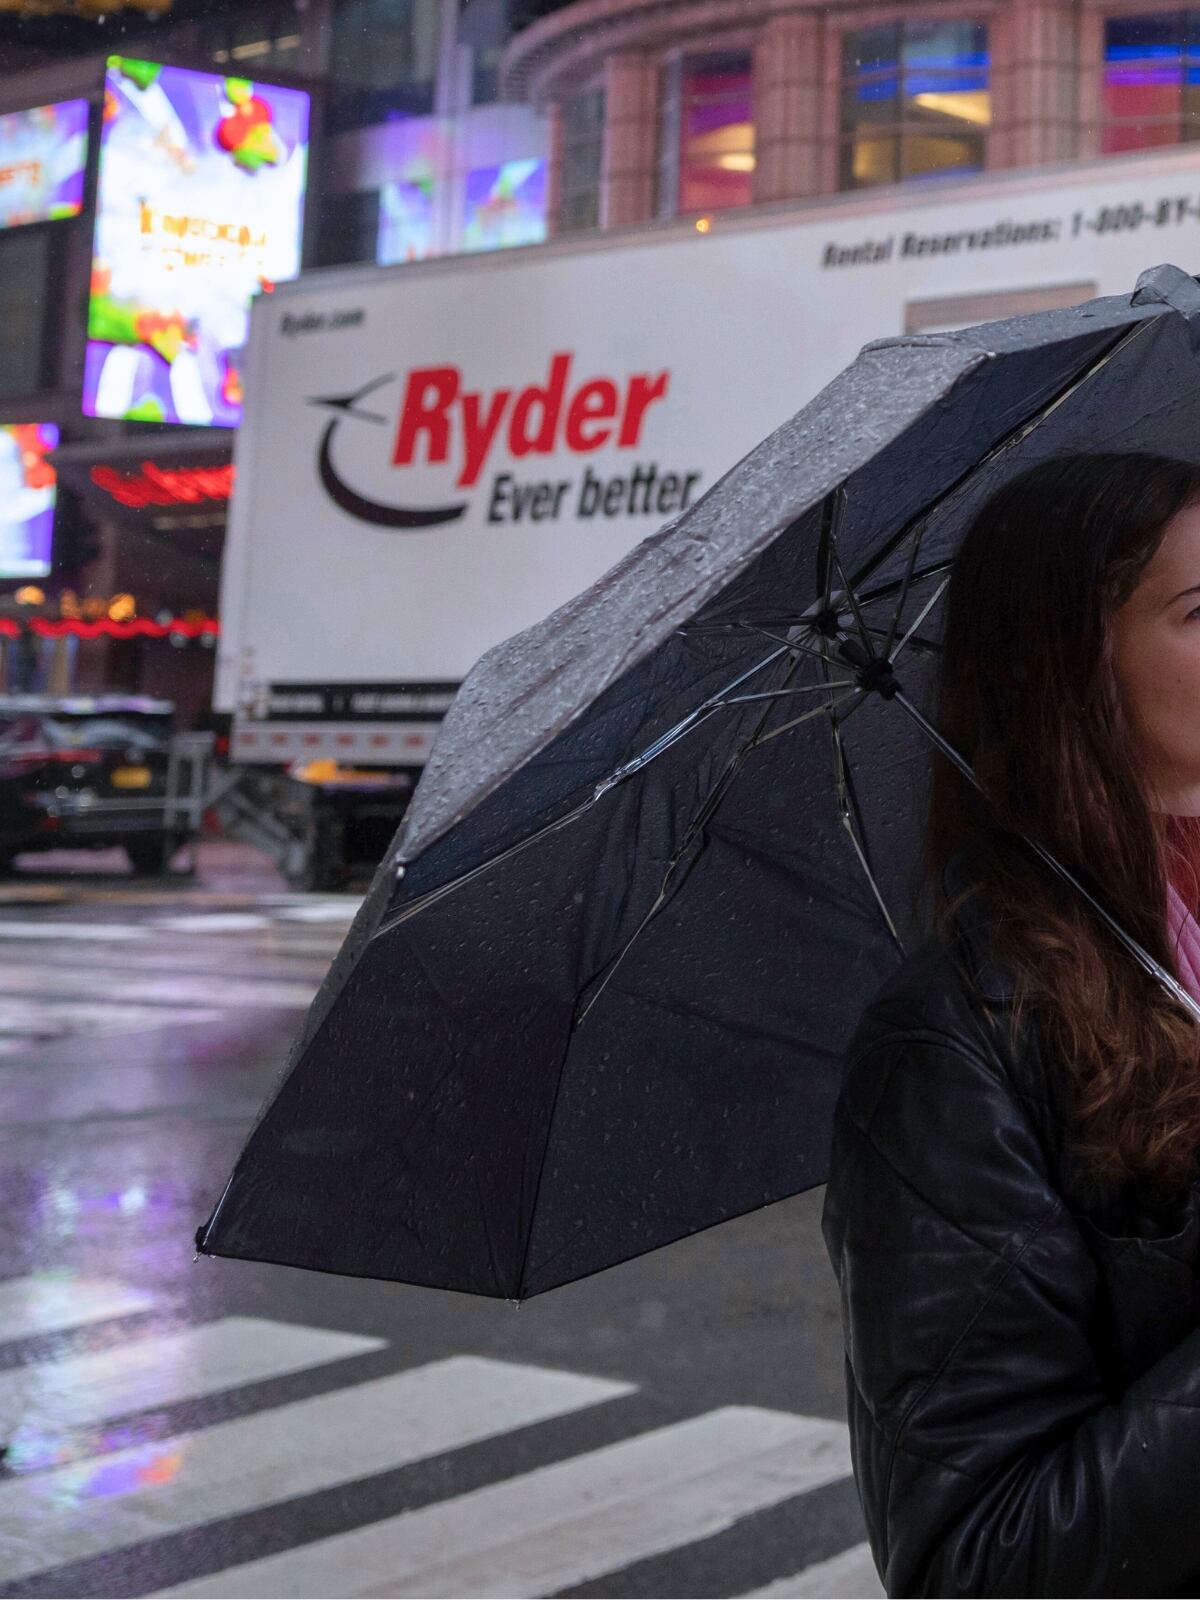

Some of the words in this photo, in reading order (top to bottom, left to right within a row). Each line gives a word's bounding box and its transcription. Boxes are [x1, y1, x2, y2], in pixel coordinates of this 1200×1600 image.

[822, 236, 893, 268] Rental
[901, 217, 1061, 259] Reservations:
[391, 352, 671, 488] Ryder
[488, 472, 570, 524] Ever
[577, 462, 701, 520] better
